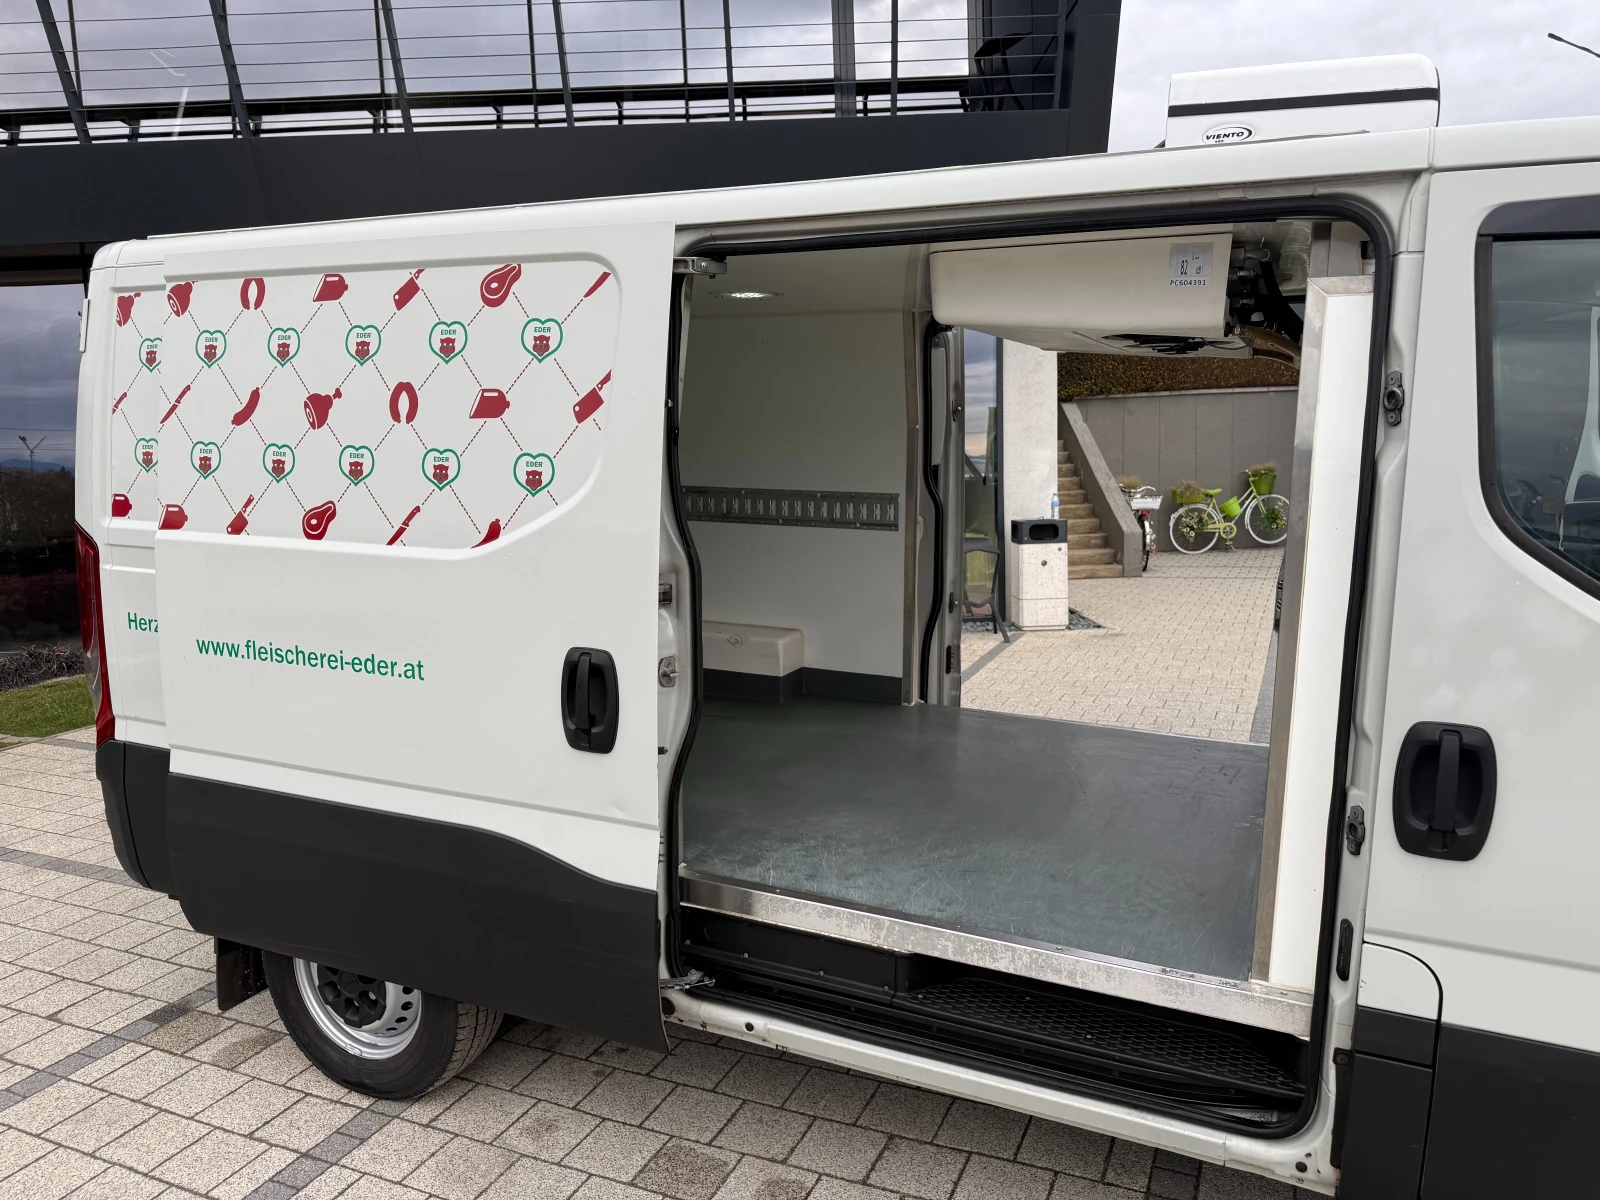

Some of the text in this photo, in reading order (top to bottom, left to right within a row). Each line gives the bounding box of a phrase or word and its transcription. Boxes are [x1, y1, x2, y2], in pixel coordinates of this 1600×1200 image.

[1205, 131, 1245, 141] VIENTO
[1180, 259, 1188, 275] 82
[440, 328, 457, 336] EDER
[272, 450, 287, 458] EDER
[525, 460, 543, 468] EDER
[195, 639, 425, 681] www.fleischerei-eder.at
